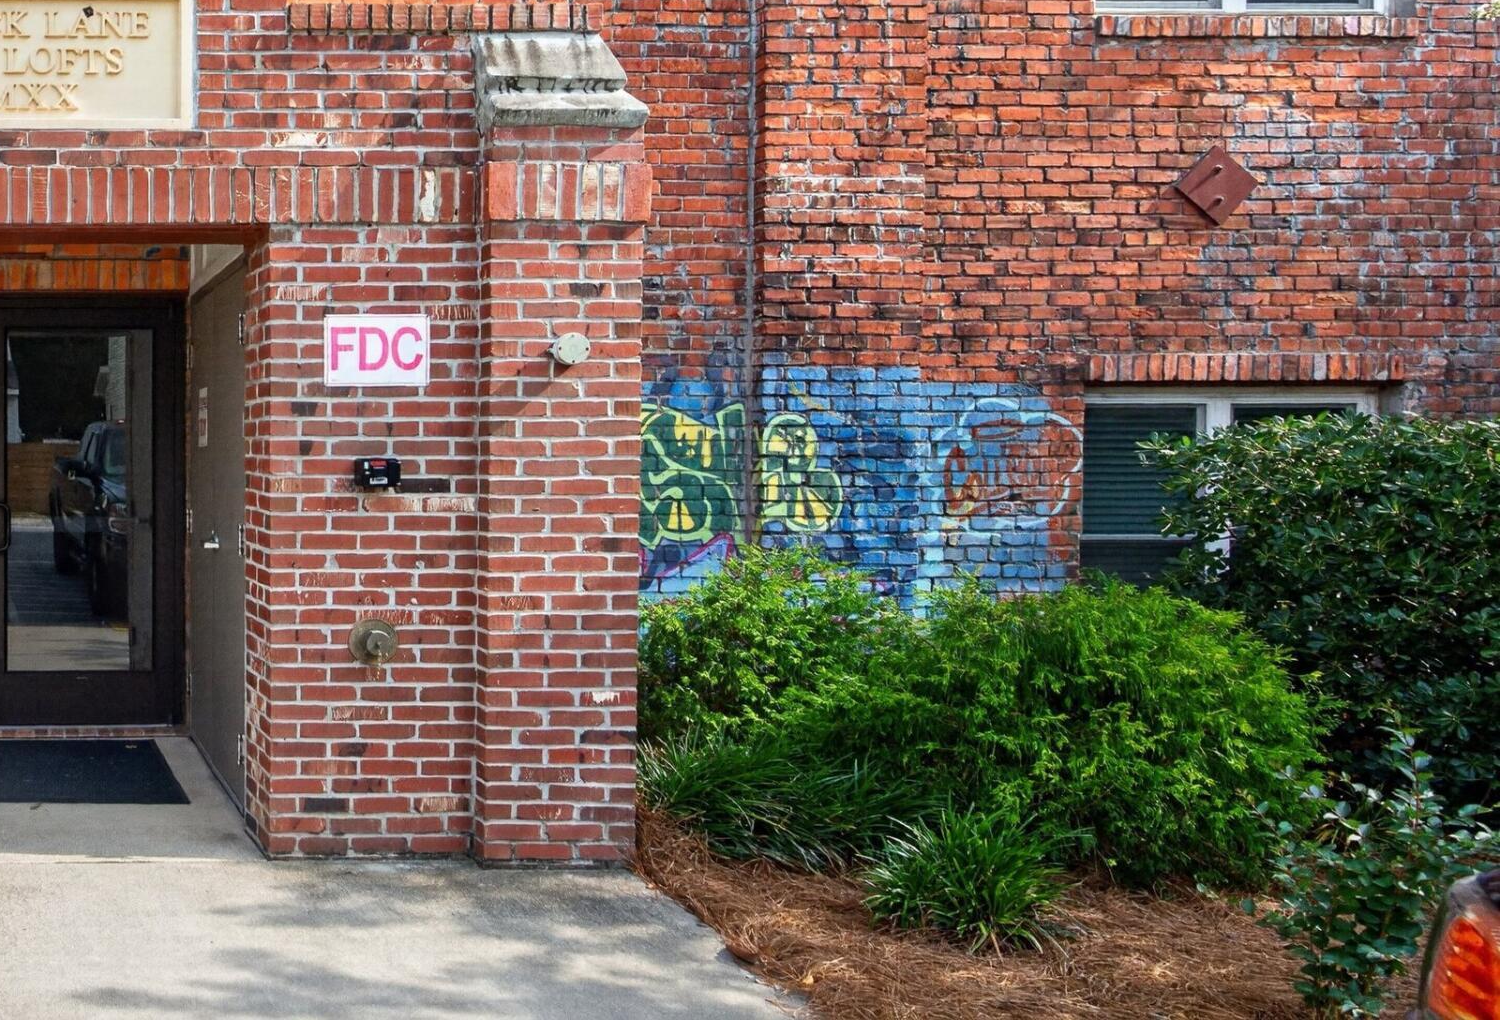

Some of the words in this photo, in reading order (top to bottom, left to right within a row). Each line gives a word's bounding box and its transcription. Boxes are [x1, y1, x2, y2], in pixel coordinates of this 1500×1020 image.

[44, 10, 151, 40] LANE
[3, 46, 125, 76] LOFTS
[329, 326, 424, 372] FDC
